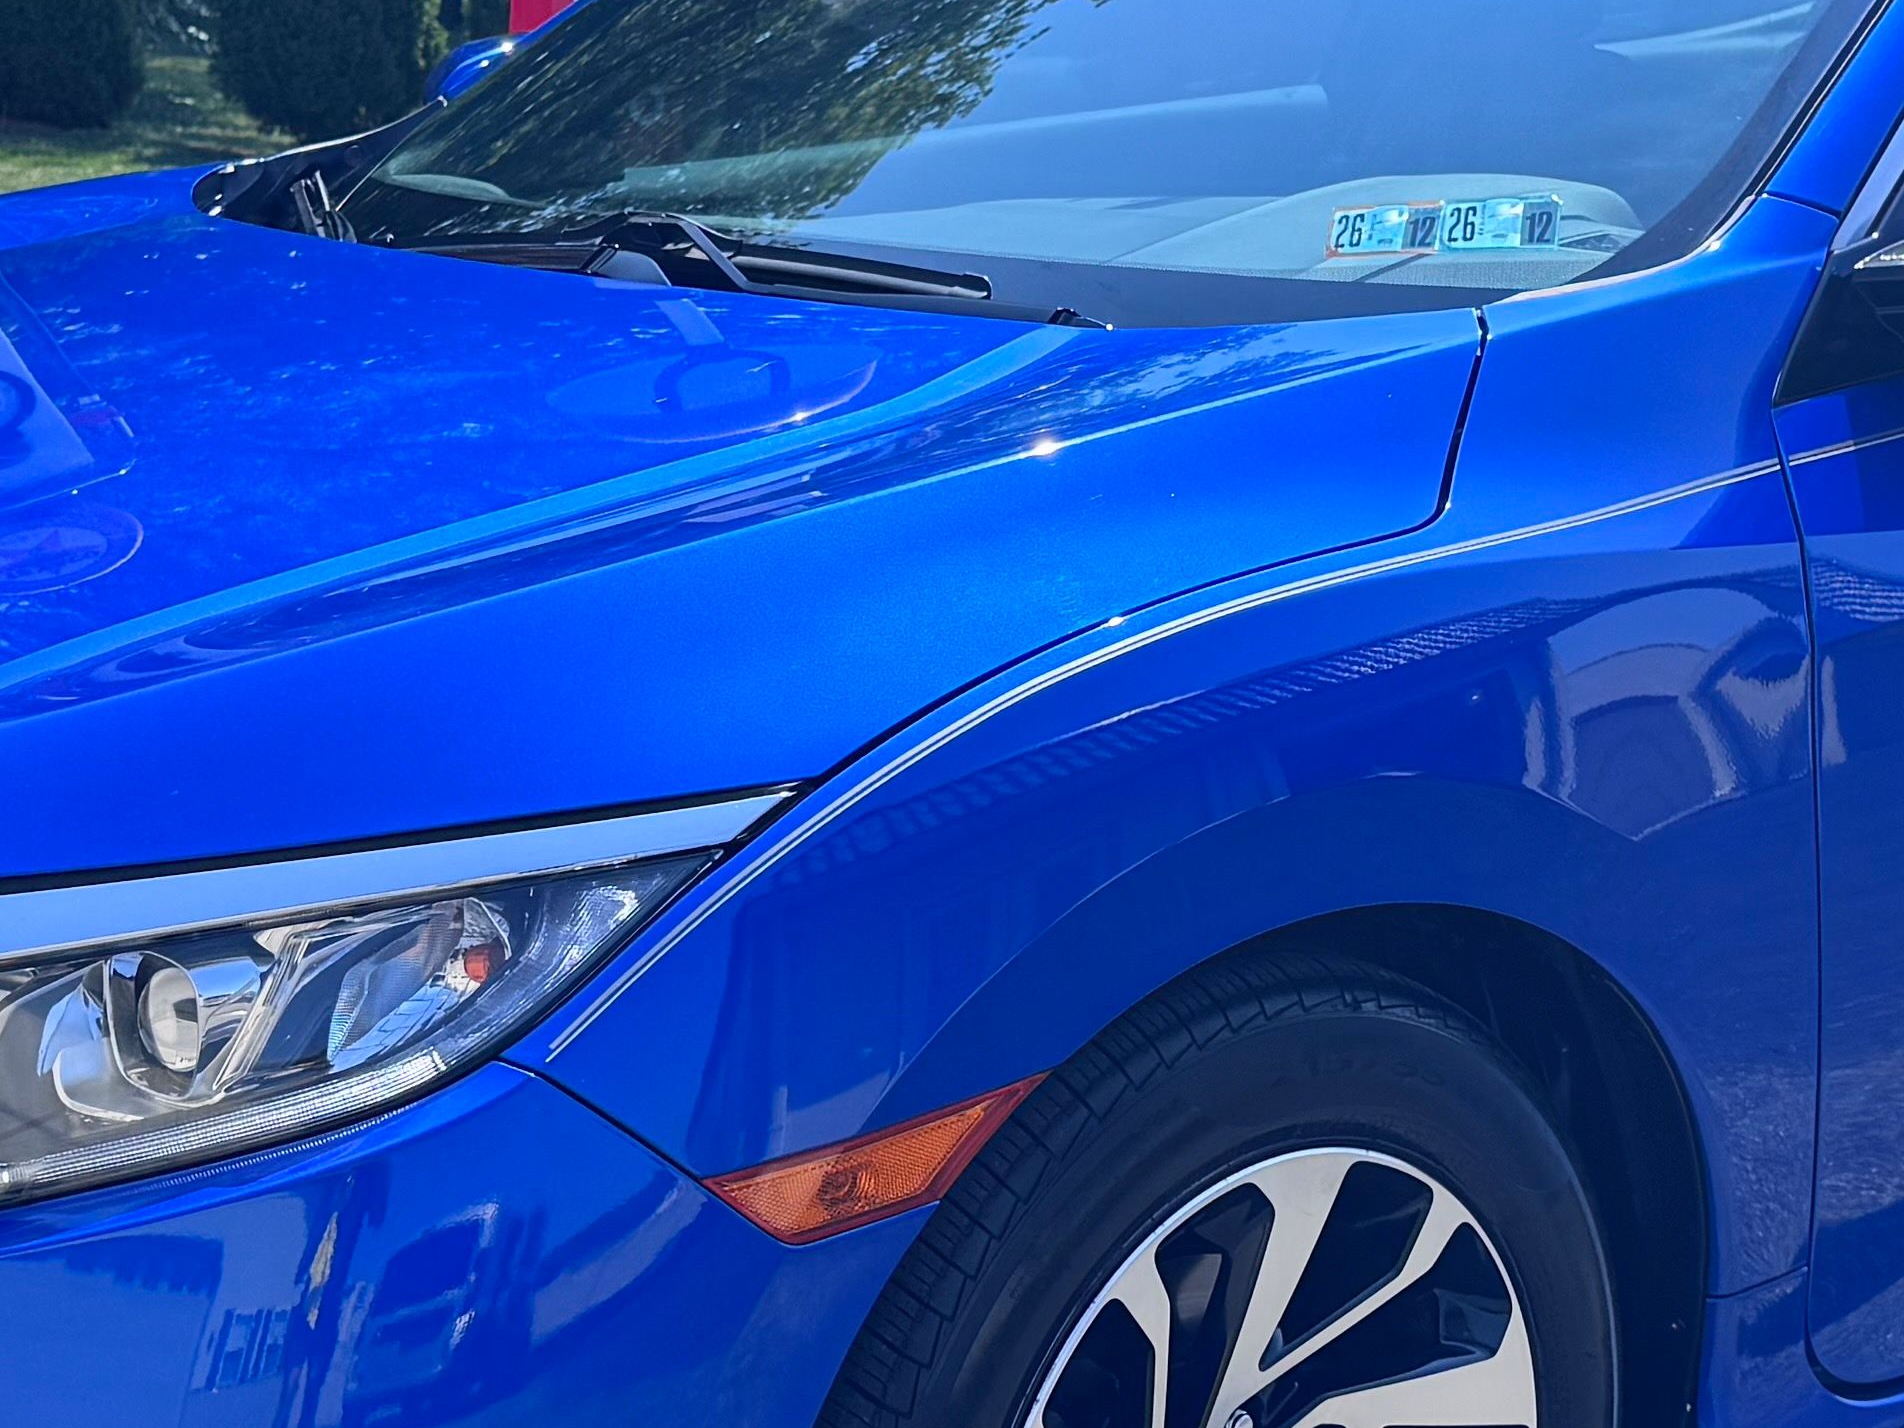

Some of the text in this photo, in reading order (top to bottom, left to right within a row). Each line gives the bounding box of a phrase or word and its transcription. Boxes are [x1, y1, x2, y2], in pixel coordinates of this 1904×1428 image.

[1334, 213, 1365, 249] 26
[1409, 215, 1436, 248] 12
[1446, 206, 1477, 243] 26
[1525, 210, 1552, 244] 12
